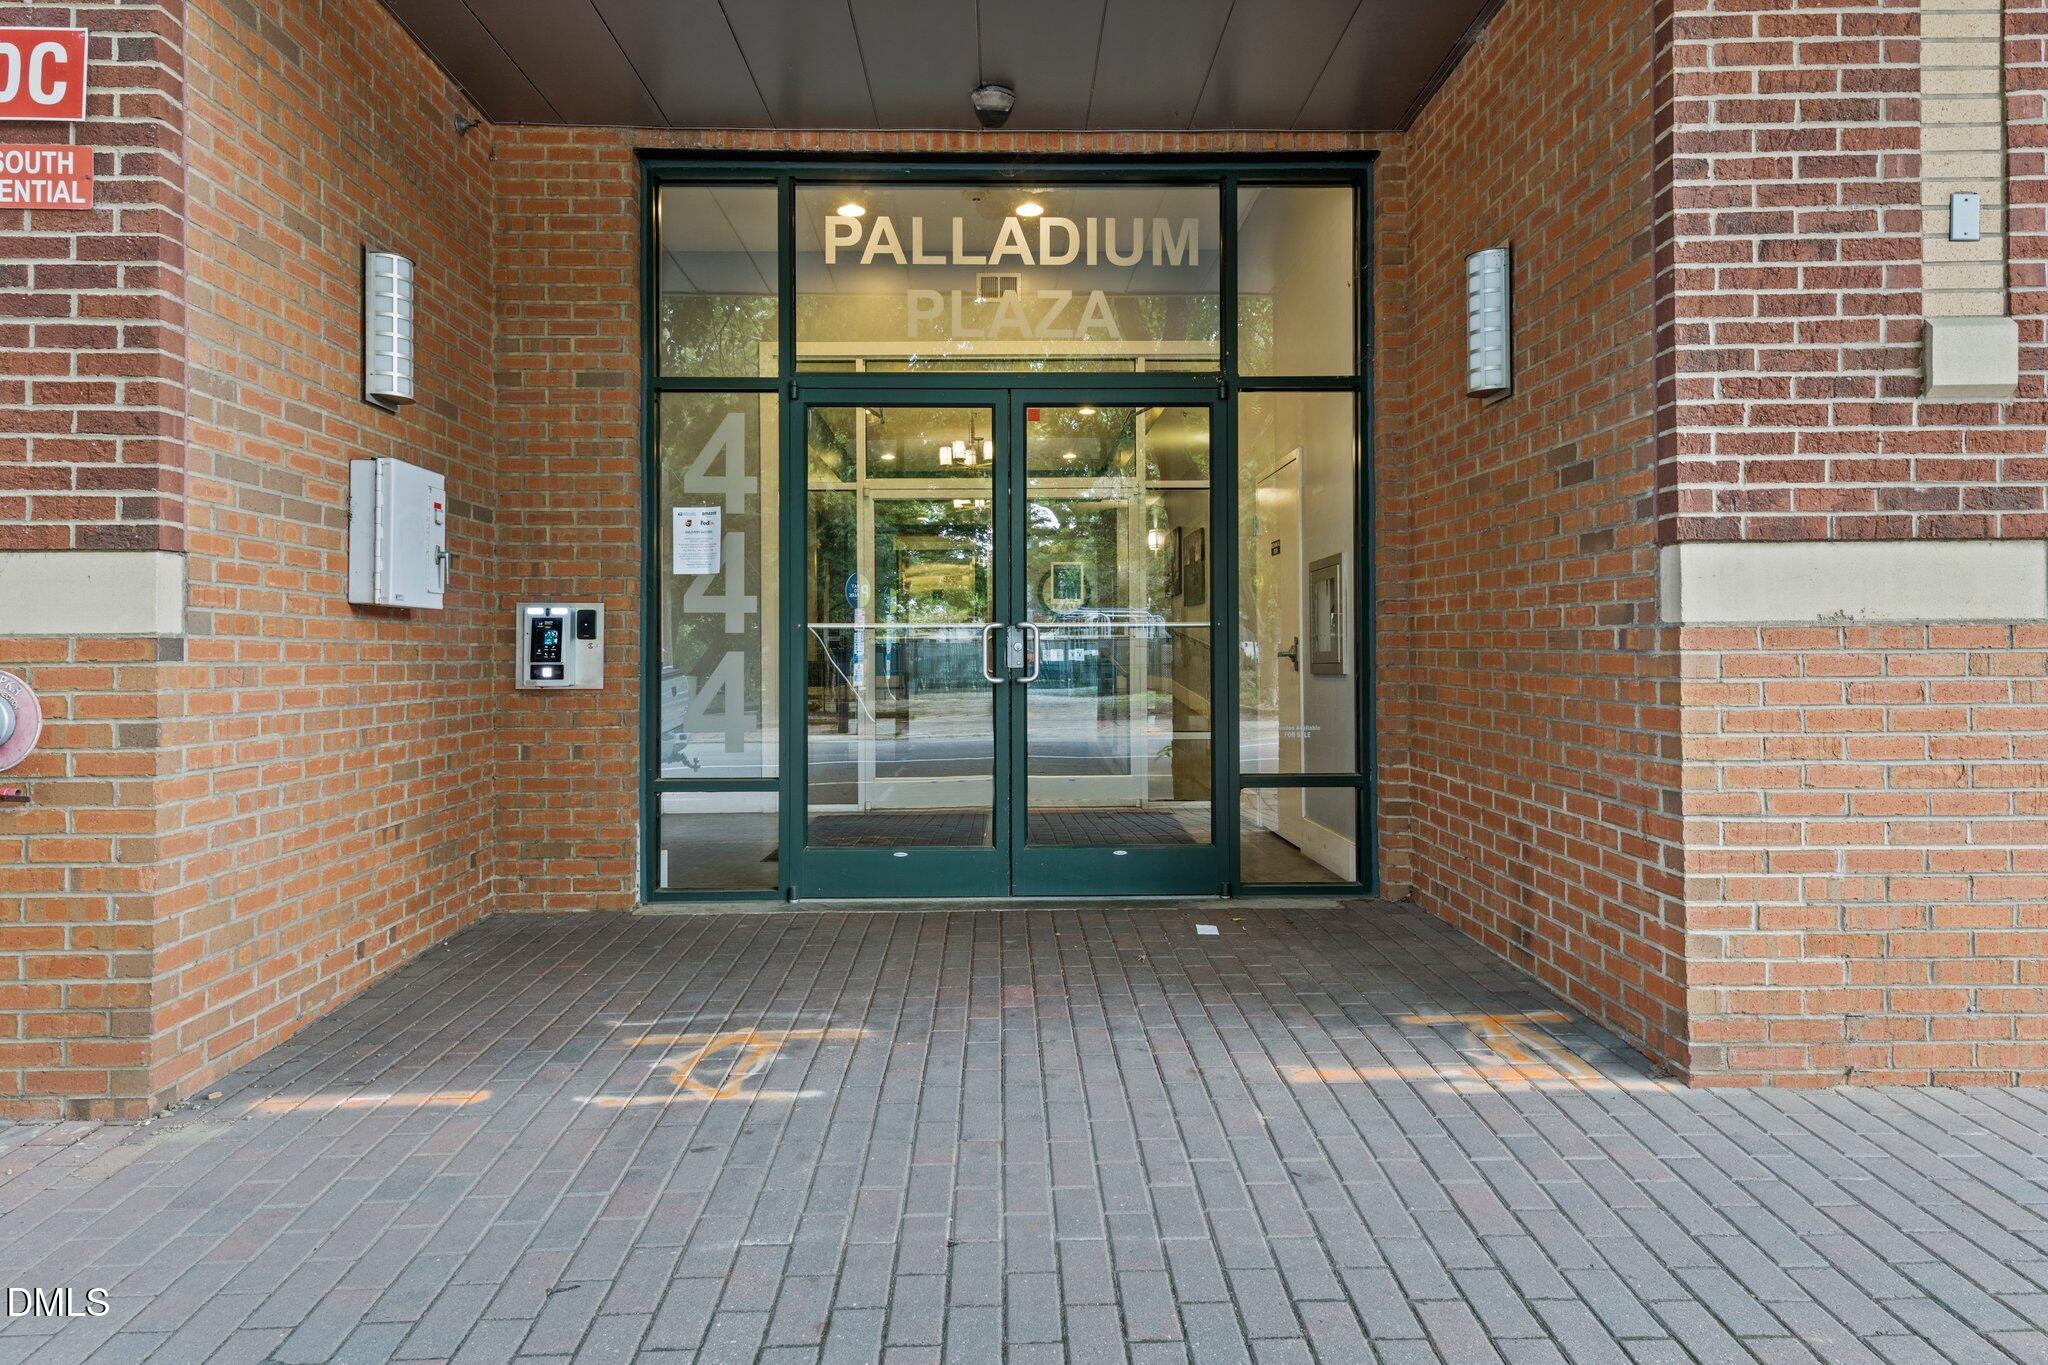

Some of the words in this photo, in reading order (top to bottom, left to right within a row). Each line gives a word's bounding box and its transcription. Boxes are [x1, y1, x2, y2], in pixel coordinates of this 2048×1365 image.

[0, 150, 74, 175] OUTH
[824, 215, 1200, 267] PALLADIUM
[906, 289, 1121, 339] PLAZA
